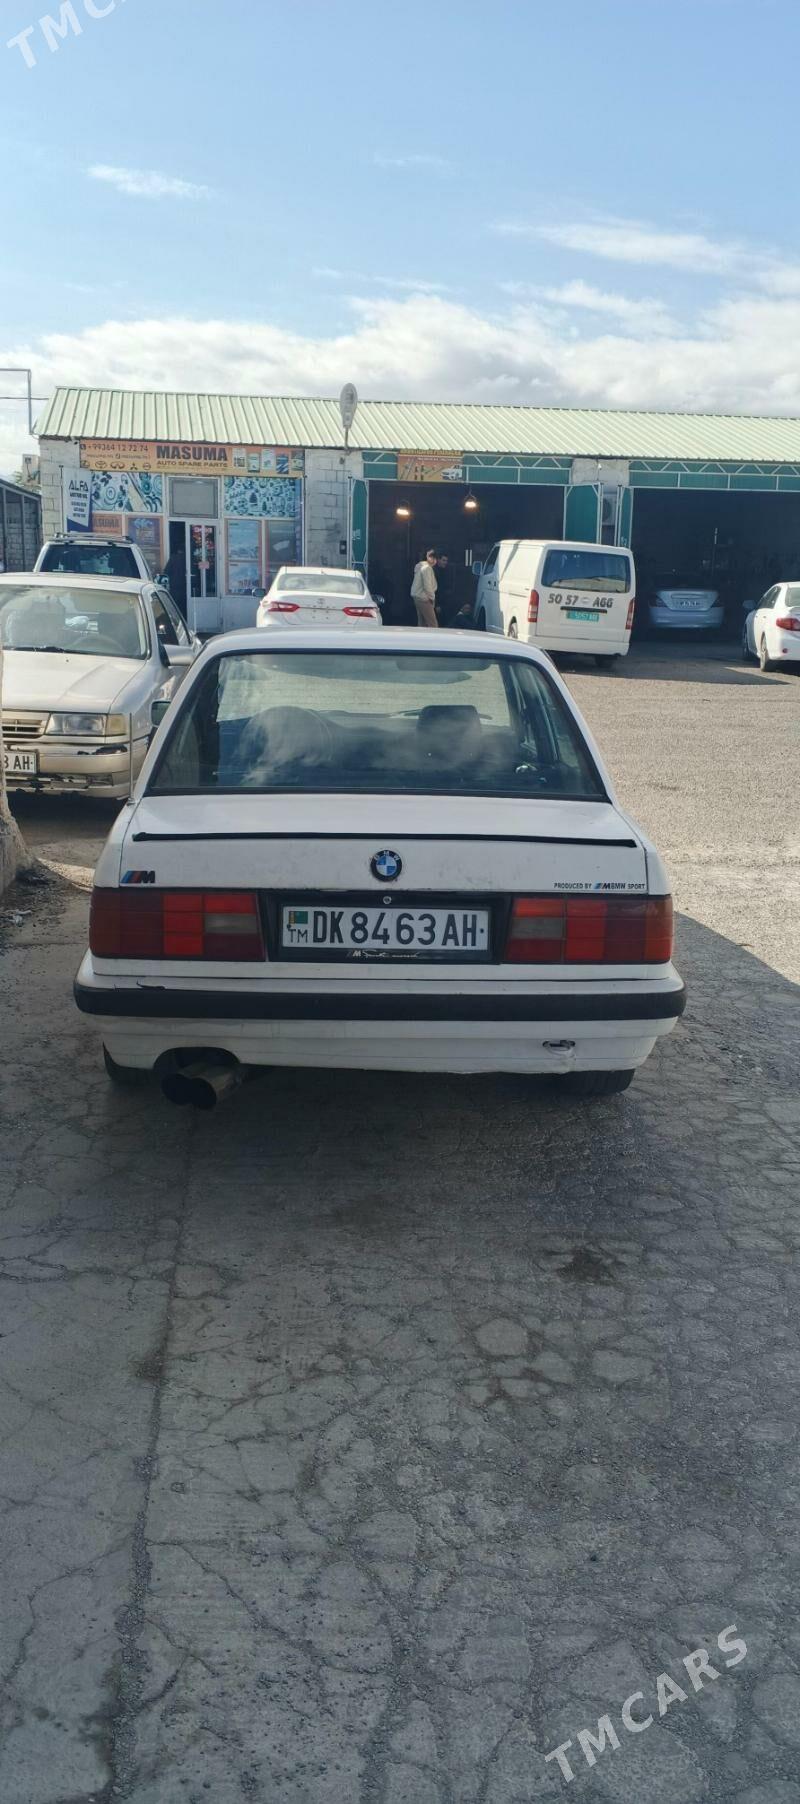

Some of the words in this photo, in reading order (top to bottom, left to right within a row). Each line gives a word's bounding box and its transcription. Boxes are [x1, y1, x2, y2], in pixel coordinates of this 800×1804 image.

[156, 445, 228, 460] MASUMA
[69, 480, 89, 491] ALFA
[288, 928, 308, 943] TM
